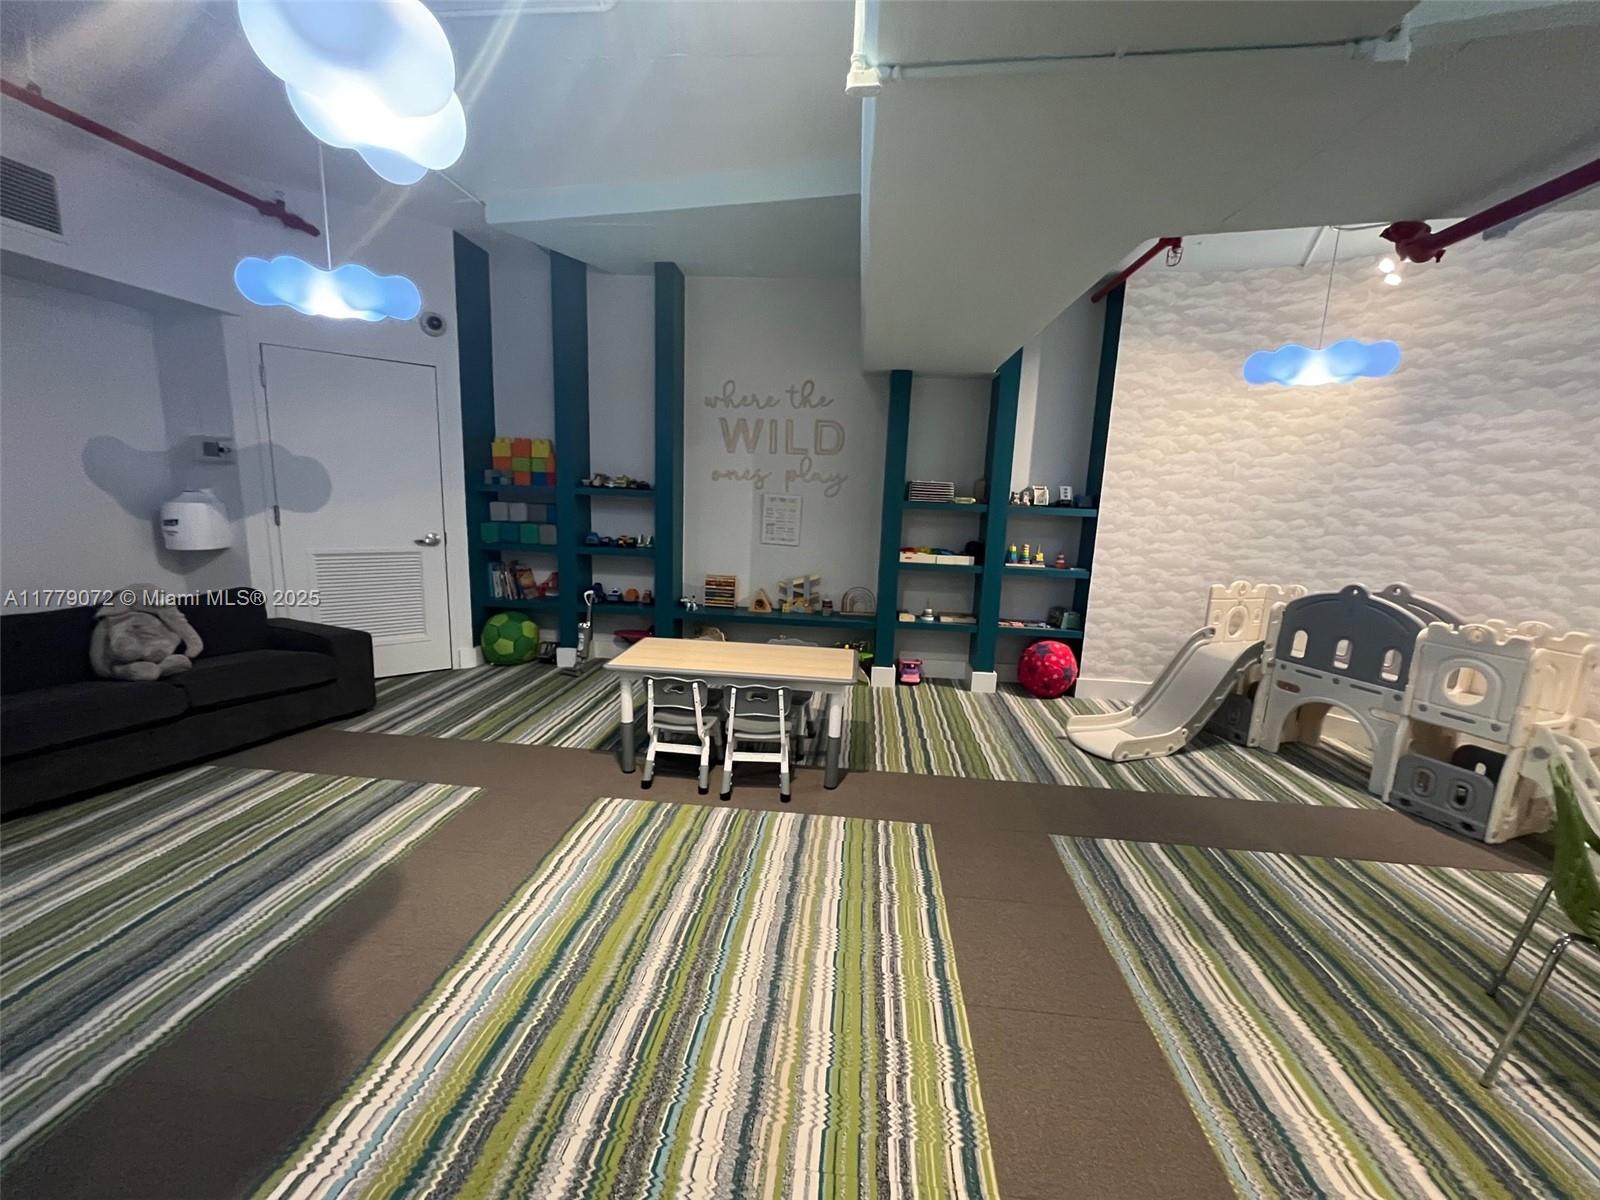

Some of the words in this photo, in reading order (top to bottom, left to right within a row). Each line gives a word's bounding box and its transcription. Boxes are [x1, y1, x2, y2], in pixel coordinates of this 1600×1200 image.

[704, 379, 780, 409] where
[785, 379, 834, 409] the
[720, 417, 845, 455] WILD
[711, 468, 772, 490] ones
[785, 455, 848, 498] play
